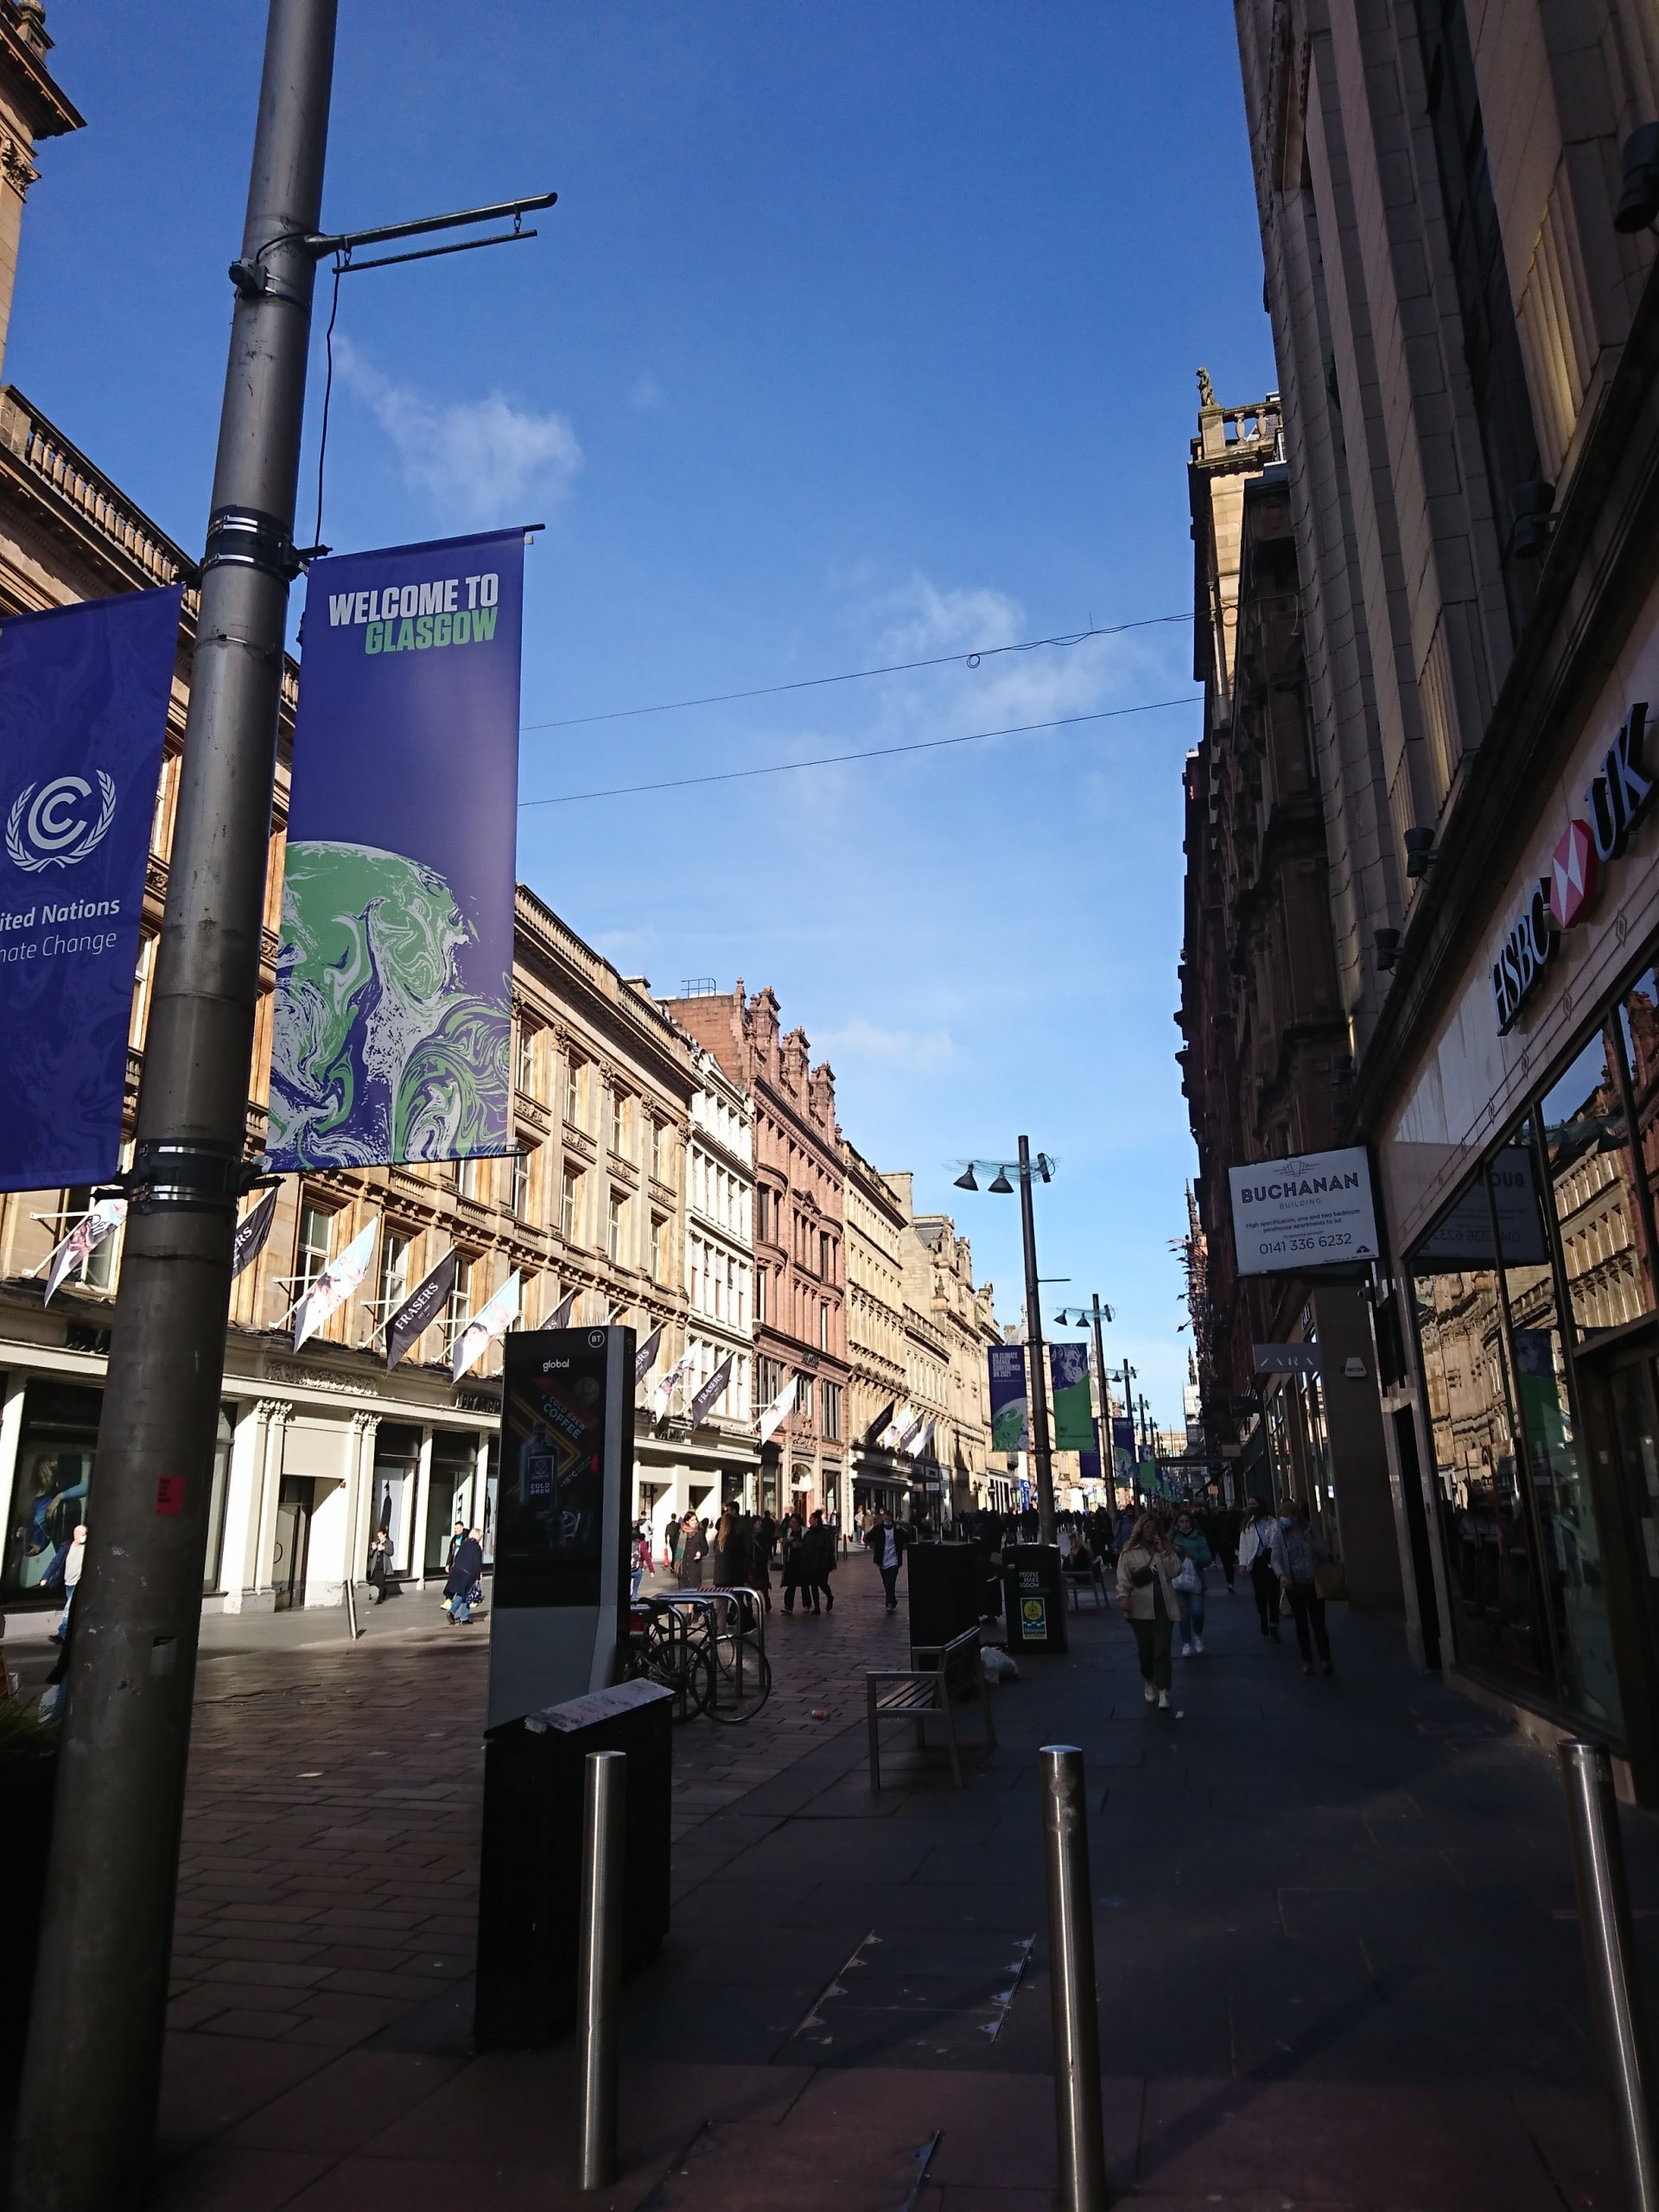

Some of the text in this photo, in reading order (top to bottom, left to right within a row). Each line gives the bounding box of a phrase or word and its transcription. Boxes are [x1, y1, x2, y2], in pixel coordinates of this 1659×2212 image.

[328, 573, 499, 626] WELCOME TO
[364, 607, 499, 655] GLASGOW
[1489, 702, 1654, 1035] HSBC UK
[41, 899, 120, 925] Nations
[42, 932, 117, 957] Change
[1241, 1173, 1359, 1204] BUCHANAN
[1279, 1198, 1322, 1210] BUILDING
[1246, 1221, 1260, 1230] High
[1260, 1216, 1297, 1228] specification,
[1262, 1224, 1293, 1234] penthouse
[1293, 1219, 1325, 1230] apartments
[1259, 1241, 1286, 1255] 0141
[1290, 1237, 1315, 1251] 336
[1319, 1233, 1352, 1248] 6232
[395, 1281, 439, 1331] FRASERS
[543, 1358, 570, 1372] global
[697, 1373, 723, 1404] FRASERS
[543, 1403, 582, 1439] COFFEE
[549, 1395, 567, 1414] COLD
[567, 1412, 587, 1431] BREW
